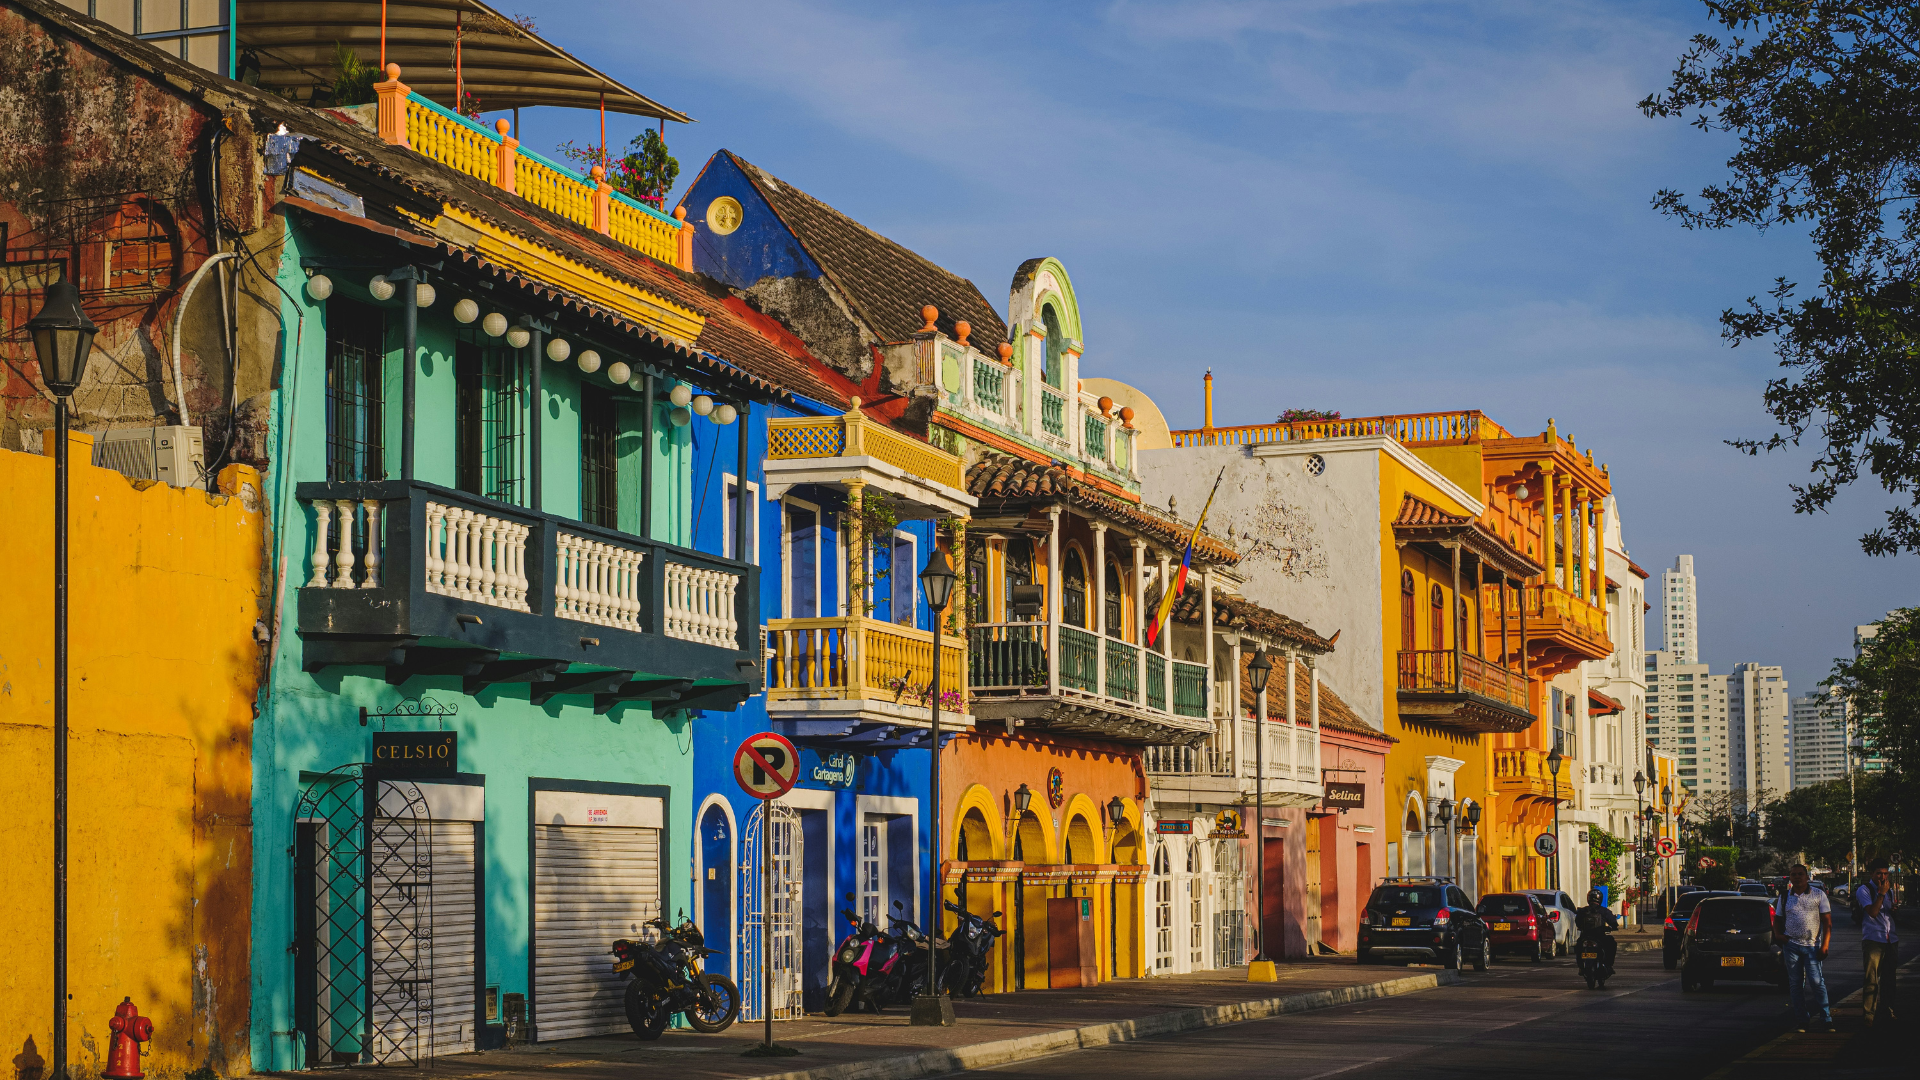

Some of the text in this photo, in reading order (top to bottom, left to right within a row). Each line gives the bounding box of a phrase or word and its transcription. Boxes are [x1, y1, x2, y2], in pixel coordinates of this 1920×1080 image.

[753, 747, 785, 785] P
[829, 754, 844, 768] Canal
[813, 766, 844, 785] Cartagena
[1329, 789, 1361, 801] Selina
[1662, 842, 1672, 853] P
